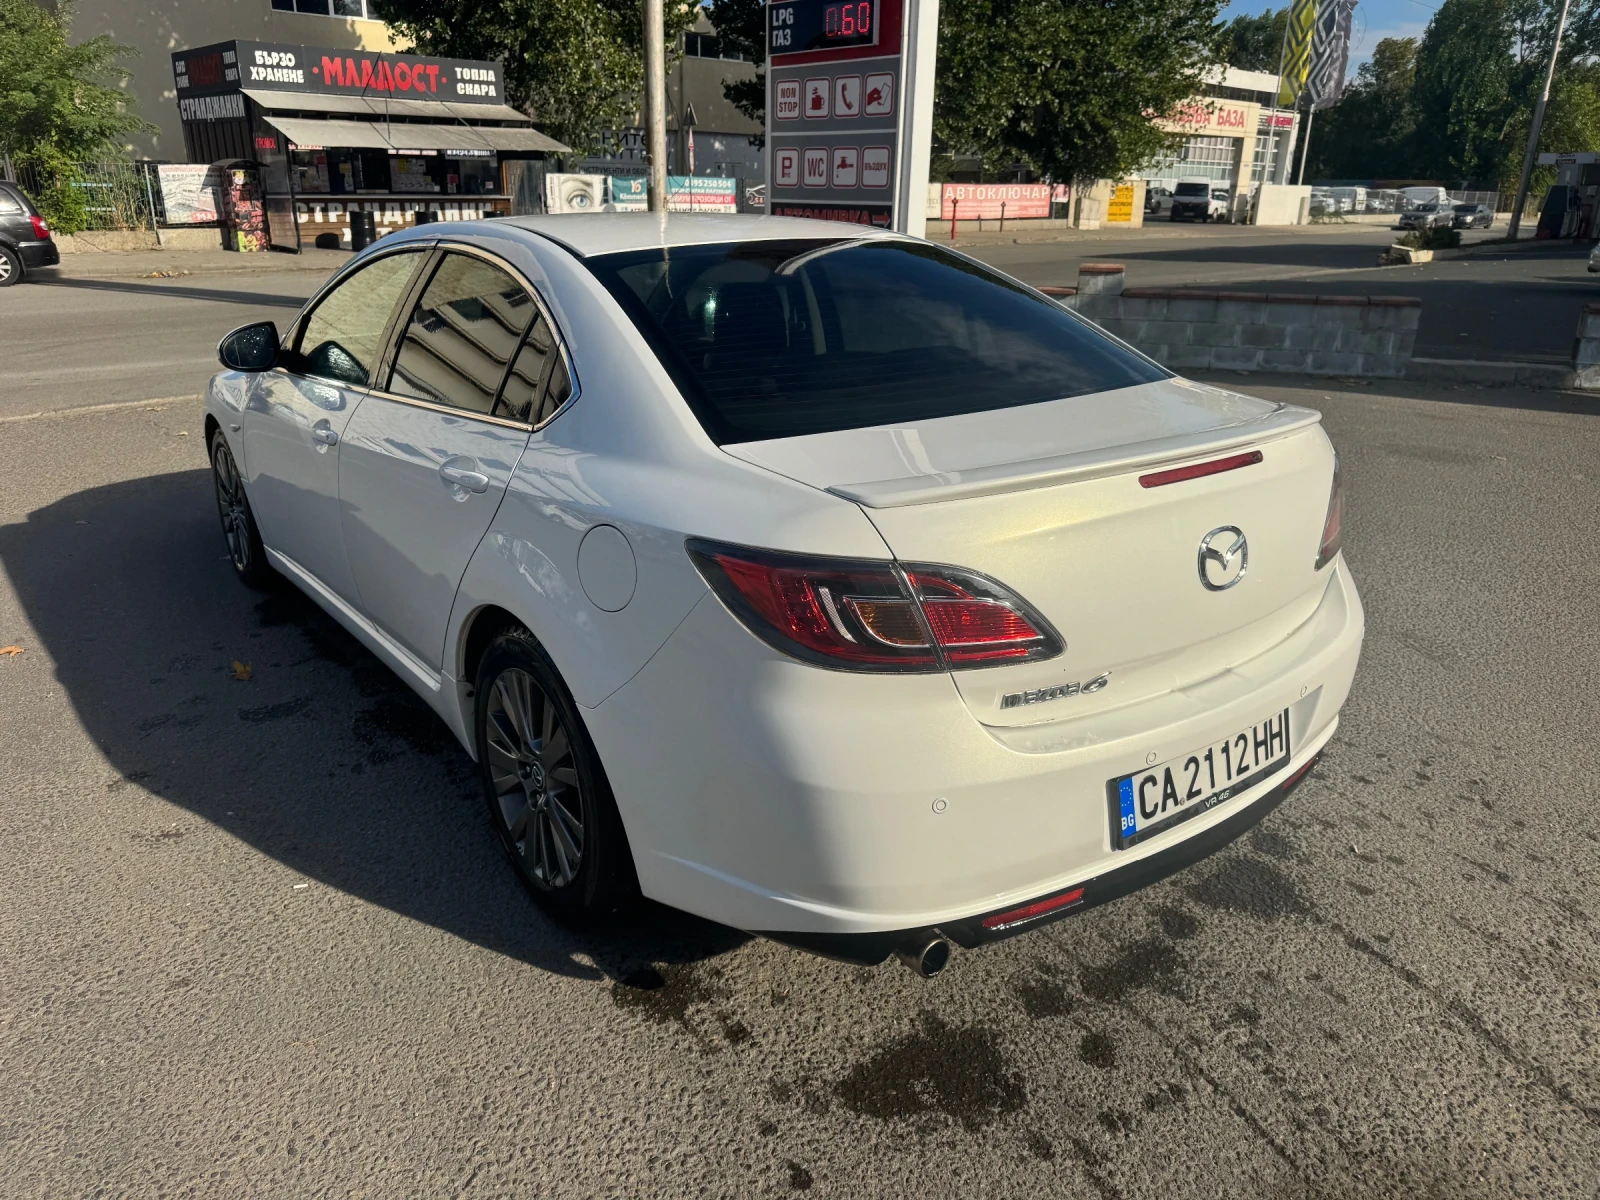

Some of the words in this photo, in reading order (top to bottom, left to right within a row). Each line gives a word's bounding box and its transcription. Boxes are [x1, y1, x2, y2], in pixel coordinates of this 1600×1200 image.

[772, 8, 794, 27] LPG
[825, 2, 870, 37] 0.60
[772, 29, 791, 47] ГАЗ
[254, 50, 296, 67] БЪРЗО
[250, 66, 304, 84] ХРАНЕНЕ
[321, 55, 440, 93] МЛАДОСТ
[455, 67, 496, 82] ТОПЛА
[456, 82, 497, 97] СКАРА
[780, 87, 797, 99] NON
[180, 94, 246, 123] СТРАНДЖАНКИ
[778, 101, 798, 113] STOP
[1216, 108, 1245, 128] БАЗА
[807, 157, 824, 178] WC
[864, 162, 887, 172] ВЪЗДУХ
[944, 186, 1049, 200] АВТОКЛЮЧАР
[1120, 814, 1135, 831] BG
